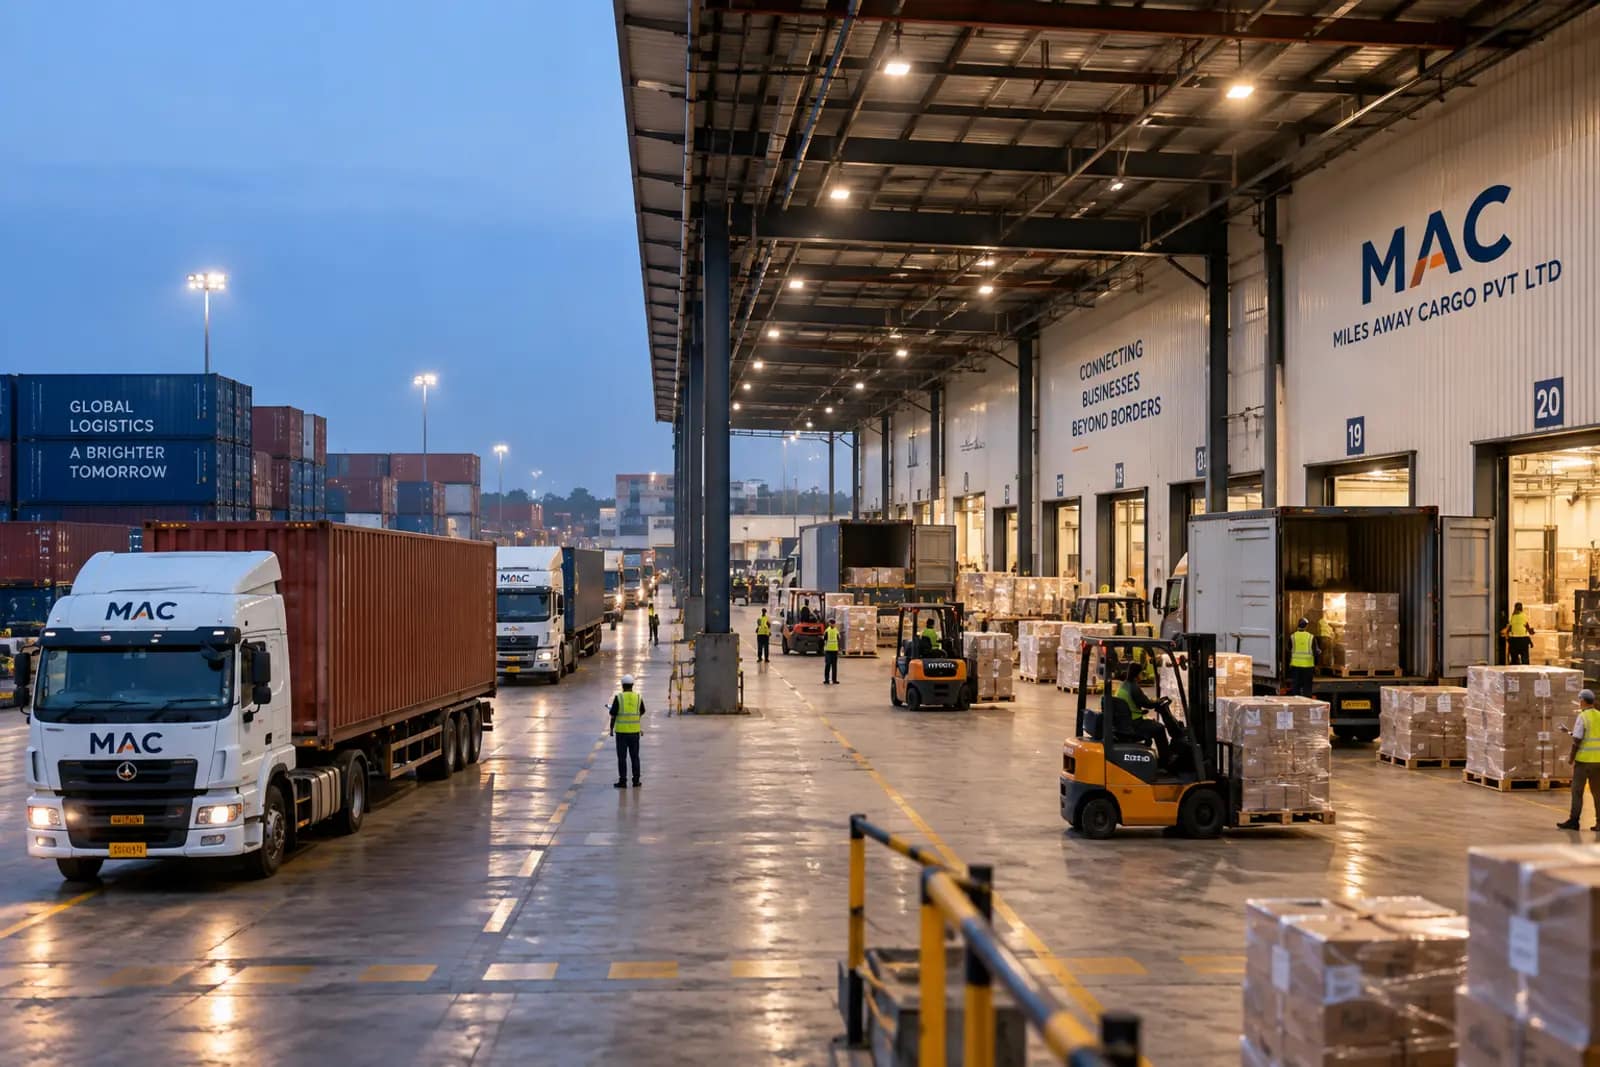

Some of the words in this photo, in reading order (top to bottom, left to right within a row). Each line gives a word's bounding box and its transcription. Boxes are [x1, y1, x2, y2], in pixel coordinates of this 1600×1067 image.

[1362, 184, 1512, 305] MAC
[1333, 322, 1369, 348] MILES
[1373, 307, 1414, 337] AWAY
[1418, 287, 1477, 322] CARGO
[1483, 272, 1519, 302] PVT
[1525, 259, 1562, 290] LTD
[1080, 339, 1144, 382] CONNECTING
[1082, 371, 1141, 408] BUSINESSES
[69, 400, 134, 413] GLOBAL
[1536, 386, 1561, 420] 20
[69, 419, 155, 433] LOGISTICS
[1072, 412, 1109, 437] BEYOND
[1111, 396, 1162, 427] BORDERS
[1348, 423, 1362, 448] 19
[69, 446, 81, 459] A
[86, 446, 165, 459] BRIGHTER
[69, 465, 167, 478] TOMORROW
[105, 601, 178, 621] MAC
[89, 731, 163, 755] MAC
